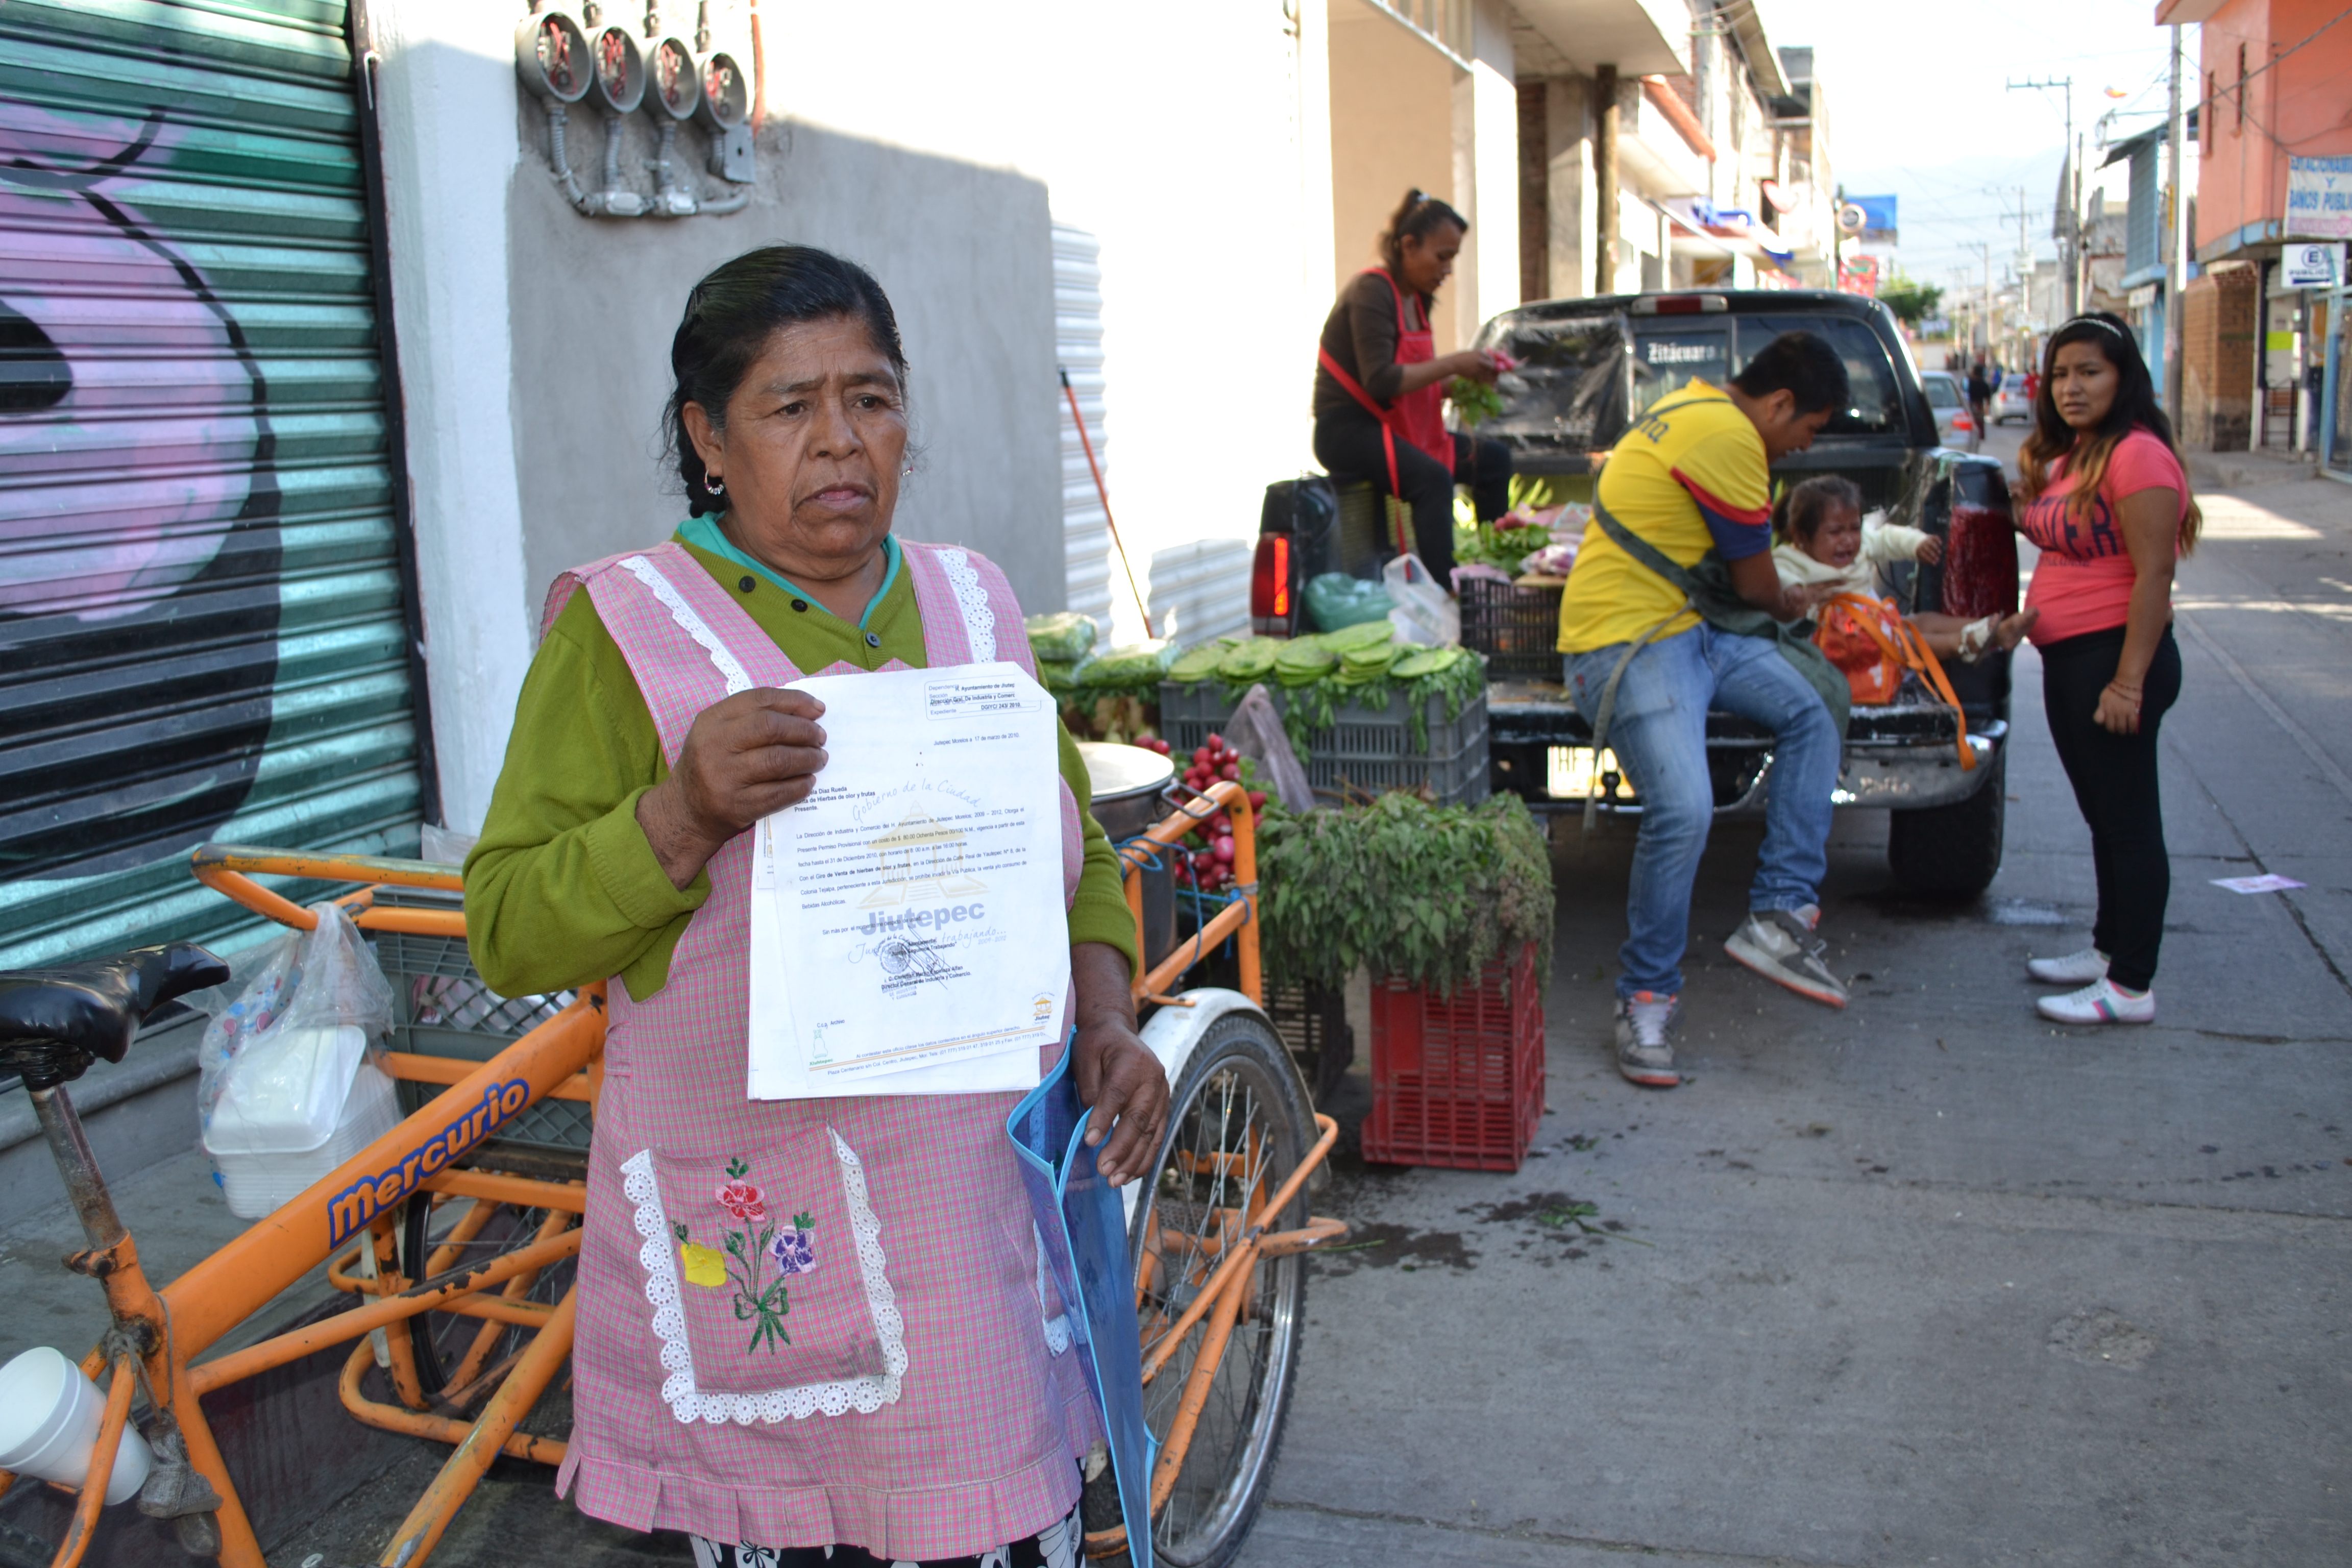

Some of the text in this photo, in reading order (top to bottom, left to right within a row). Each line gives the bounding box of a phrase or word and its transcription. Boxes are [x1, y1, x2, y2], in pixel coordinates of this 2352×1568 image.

[2326, 177, 2336, 189] Y
[2308, 251, 2319, 263] E
[853, 780, 981, 823] Gobierno Ciudad
[898, 819, 927, 827] Ayuntamiento
[837, 882, 866, 891] perteneciente
[861, 903, 985, 936] Jiutepec
[328, 1078, 529, 1250] mercurio
